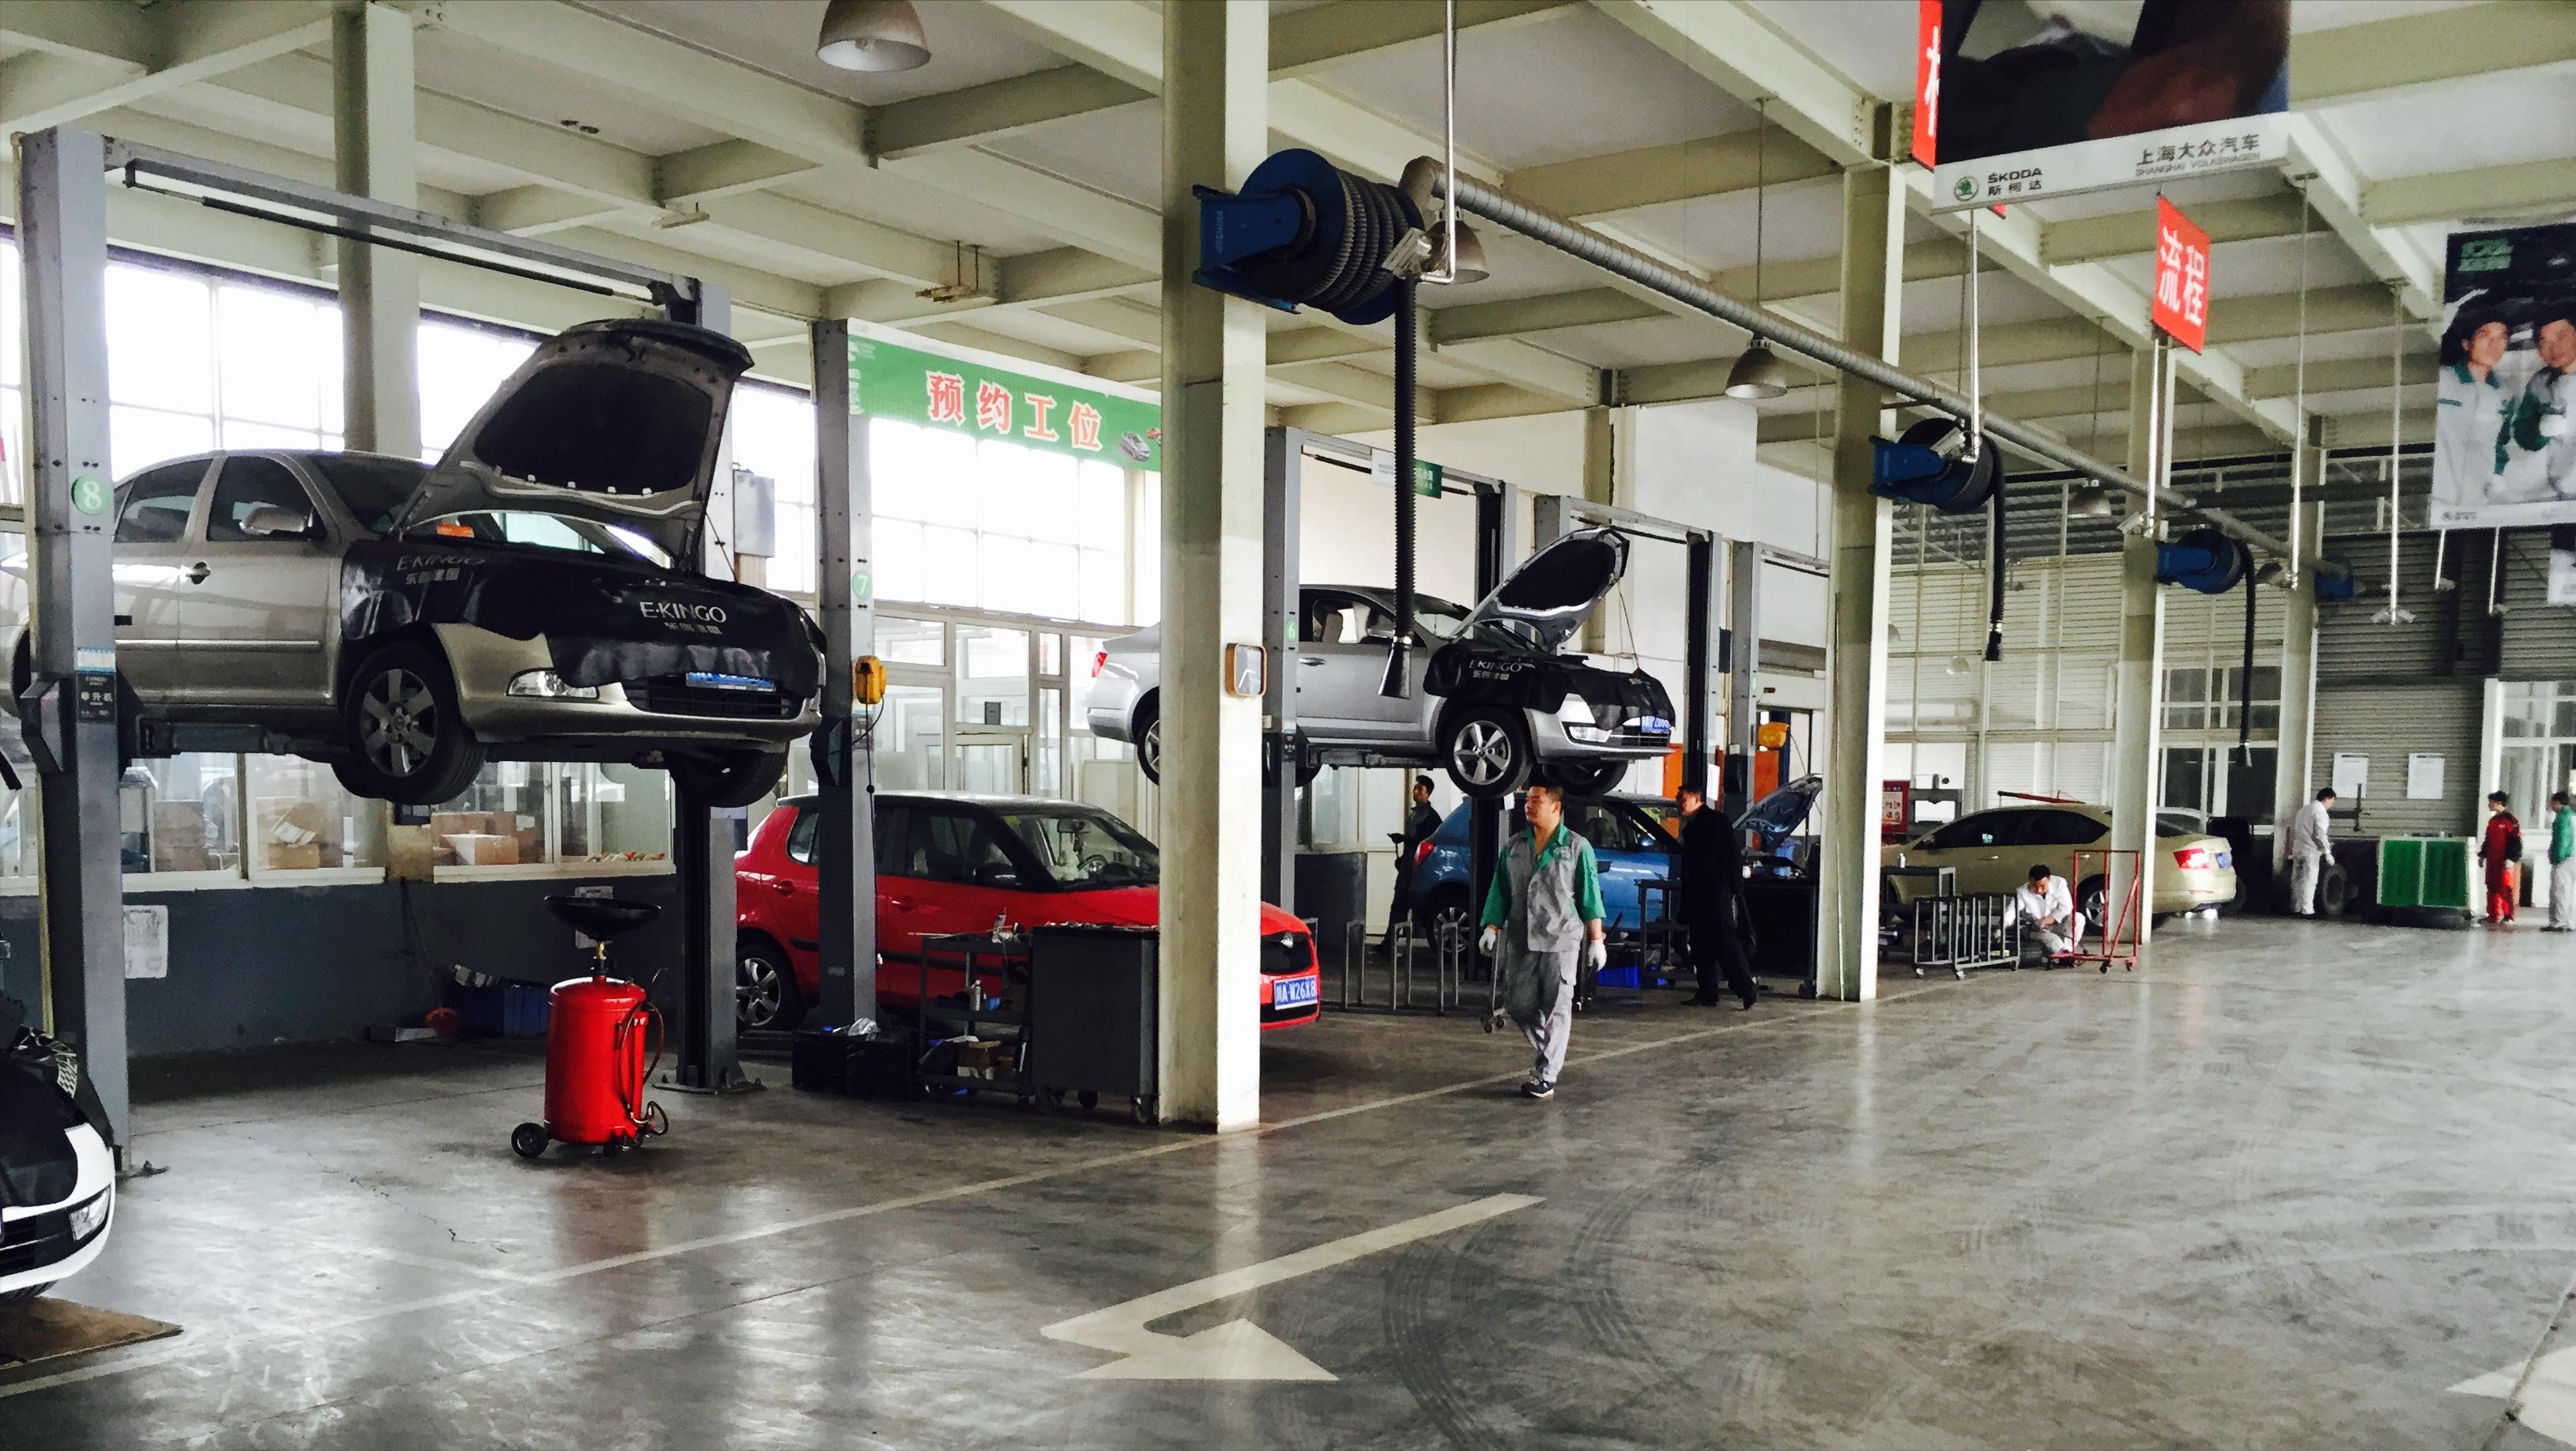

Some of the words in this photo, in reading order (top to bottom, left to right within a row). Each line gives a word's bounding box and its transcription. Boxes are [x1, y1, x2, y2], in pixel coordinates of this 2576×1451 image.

[2137, 133, 2260, 166] 上海大众汽车
[1987, 180, 2042, 197] 斯柯达
[2158, 224, 2205, 326] 流程
[926, 369, 1103, 452] 预约工位
[82, 480, 102, 510] 8
[858, 574, 869, 595] 7
[1288, 622, 1296, 639] 6
